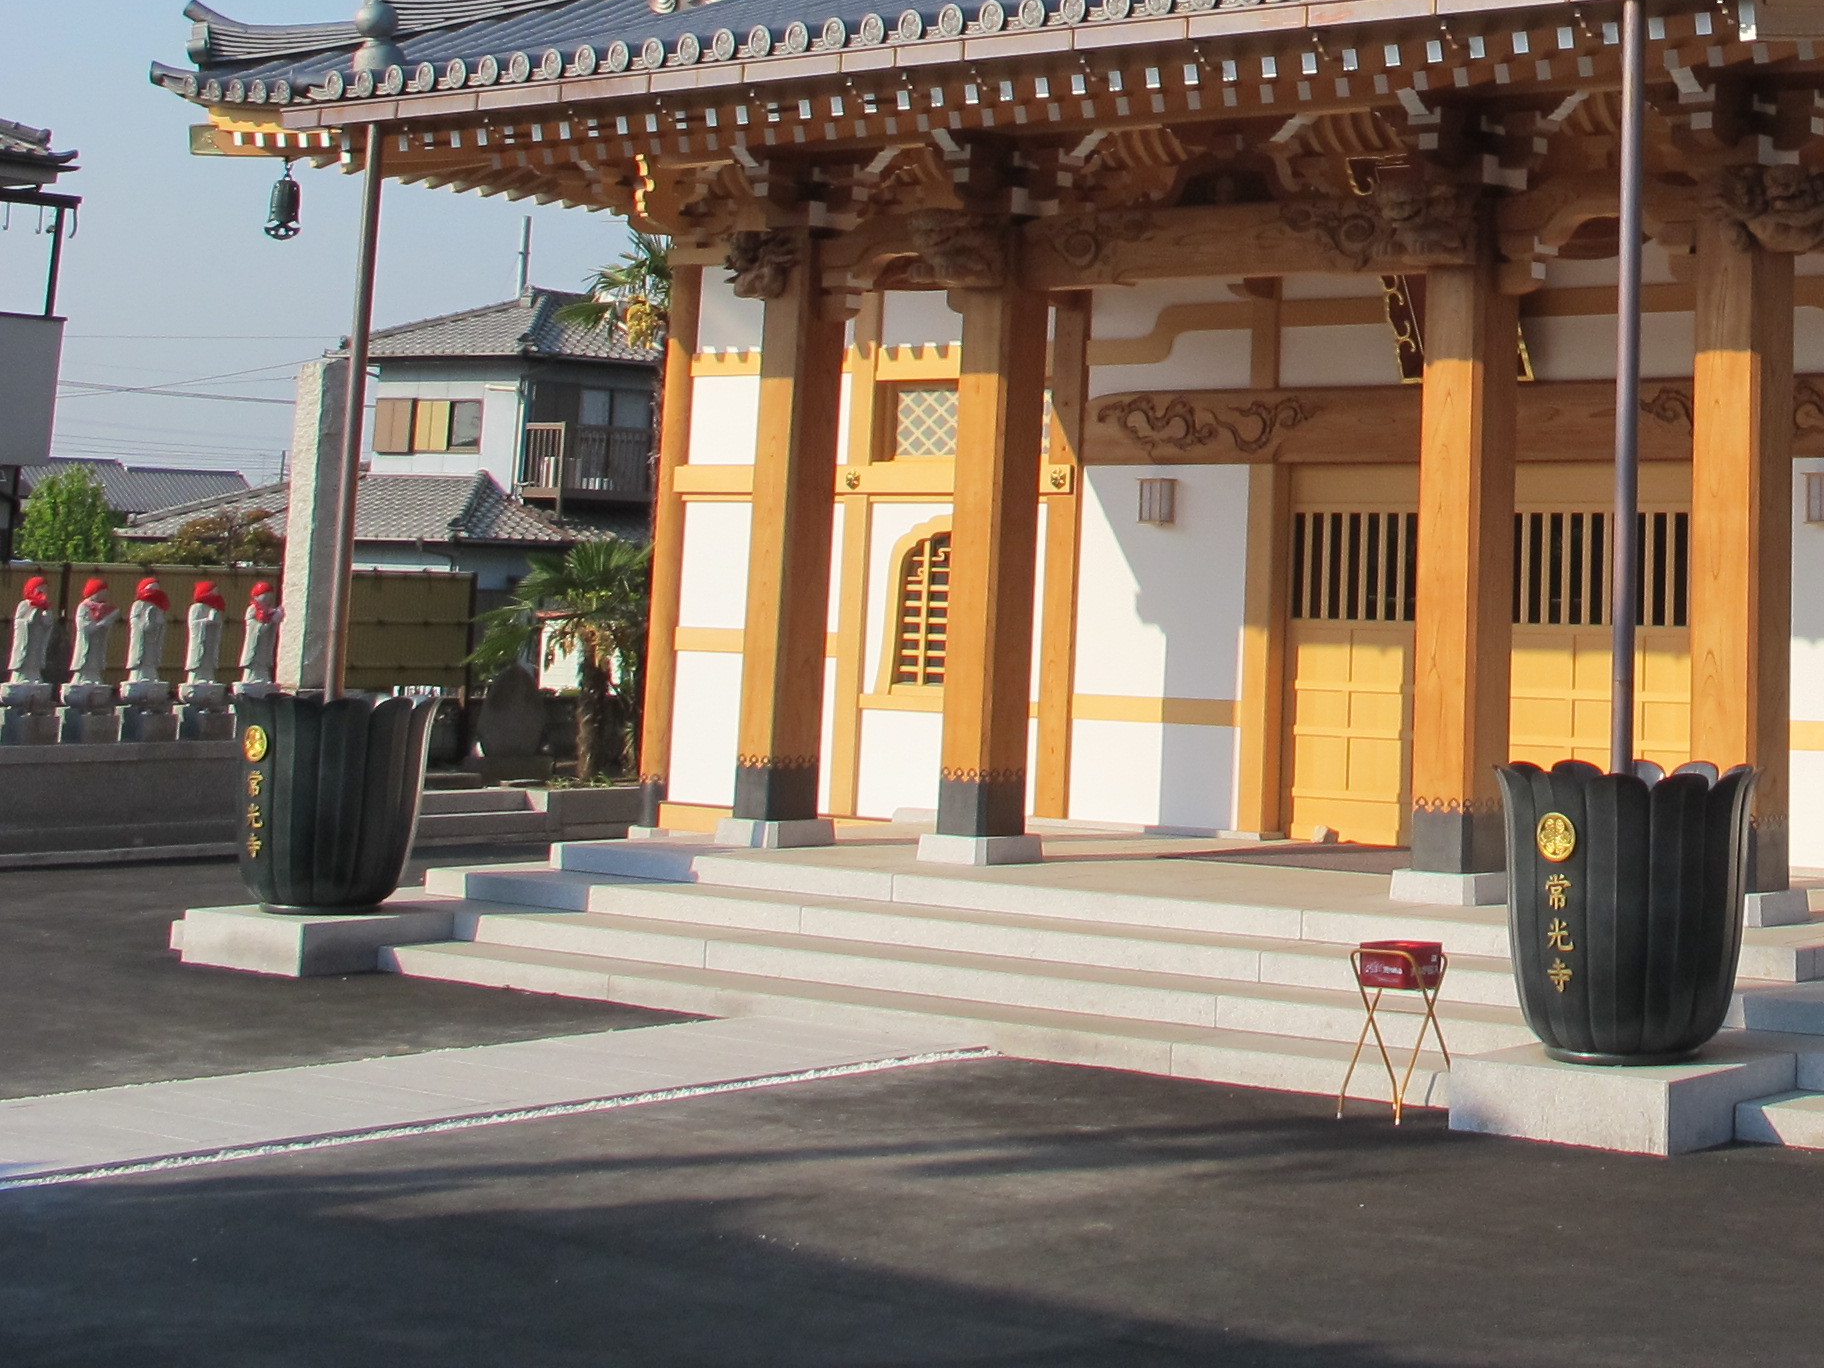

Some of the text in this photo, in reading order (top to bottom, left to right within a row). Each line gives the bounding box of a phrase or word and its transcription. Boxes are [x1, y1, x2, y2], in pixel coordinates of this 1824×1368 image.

[246, 770, 264, 858] 常光寺
[1545, 873, 1575, 992] 常光寺
